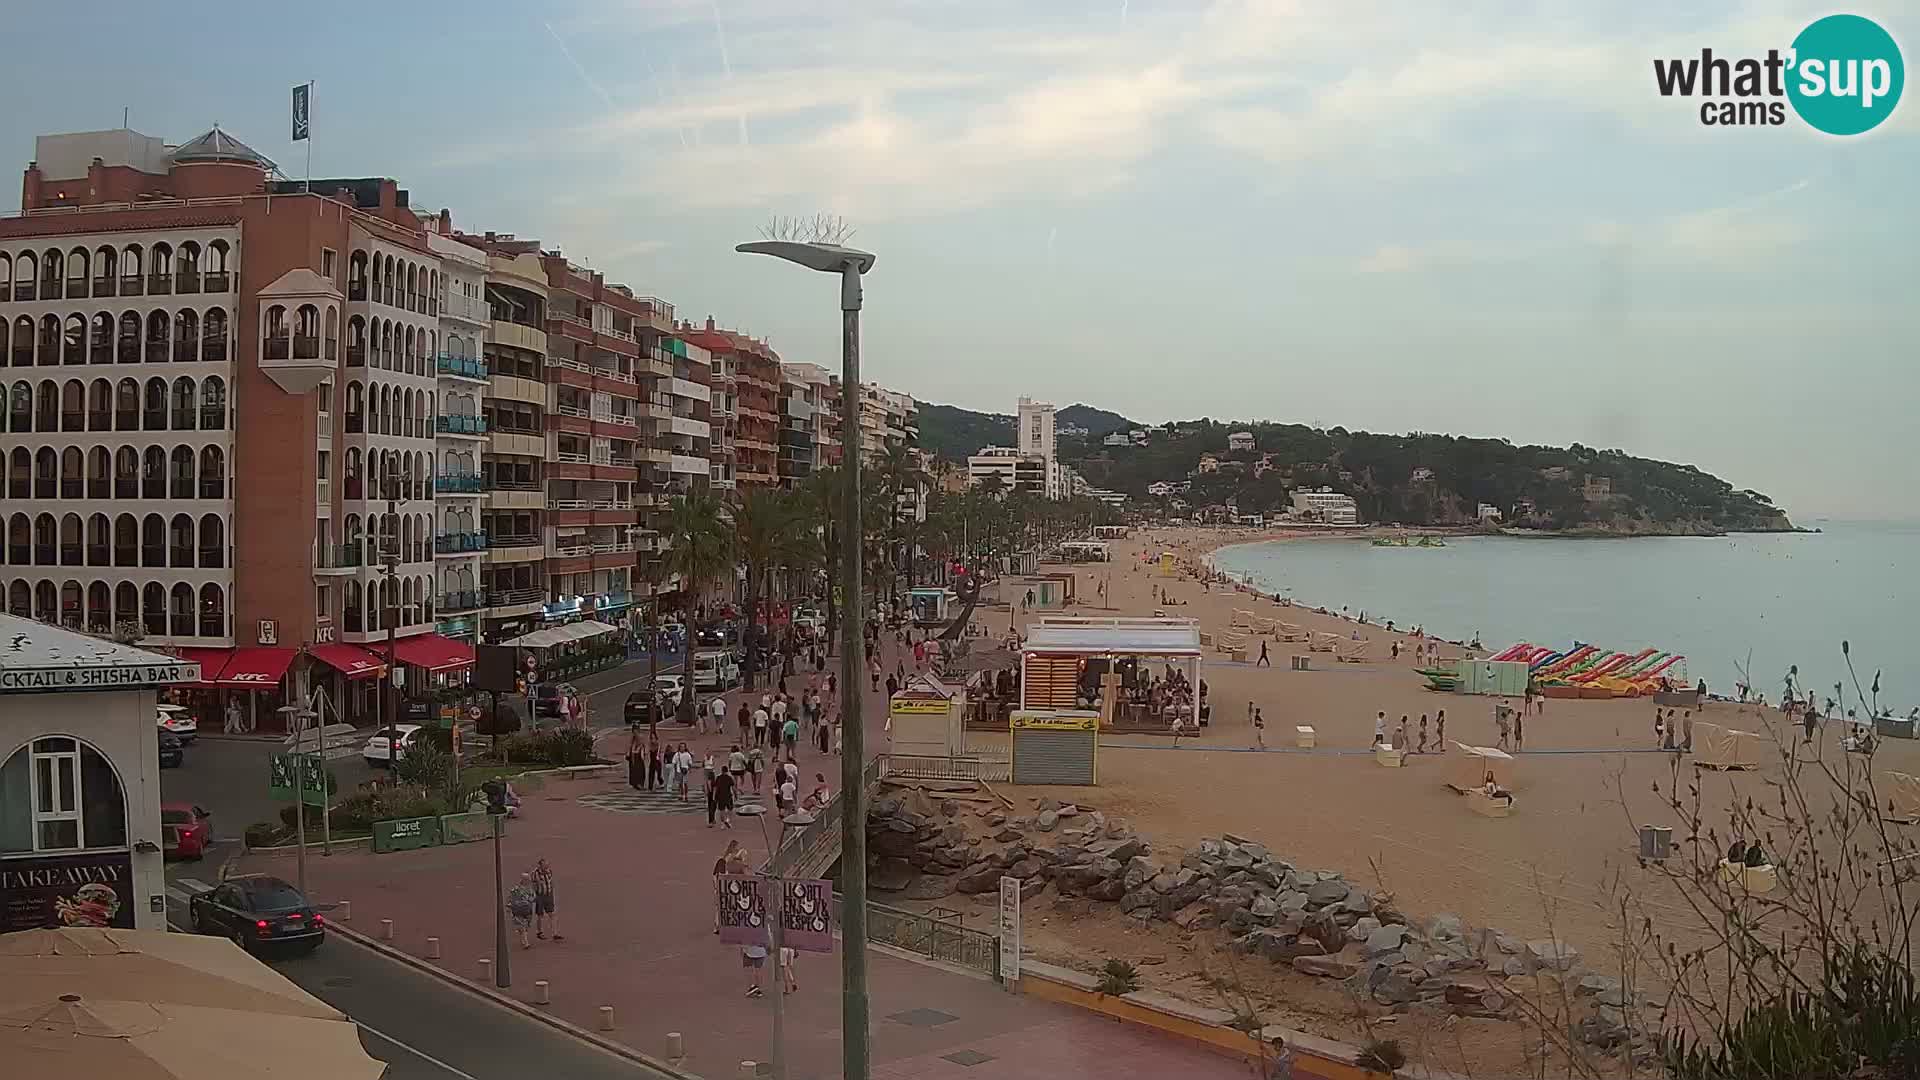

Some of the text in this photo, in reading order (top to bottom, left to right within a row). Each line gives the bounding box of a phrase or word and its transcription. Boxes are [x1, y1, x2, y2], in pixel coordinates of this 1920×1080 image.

[316, 626, 335, 643] KFC
[65, 671, 76, 685] &
[81, 668, 142, 685] SHISHA
[149, 667, 180, 682] BAR
[231, 673, 270, 681] KFC
[1, 865, 123, 888] TAKEAWAY
